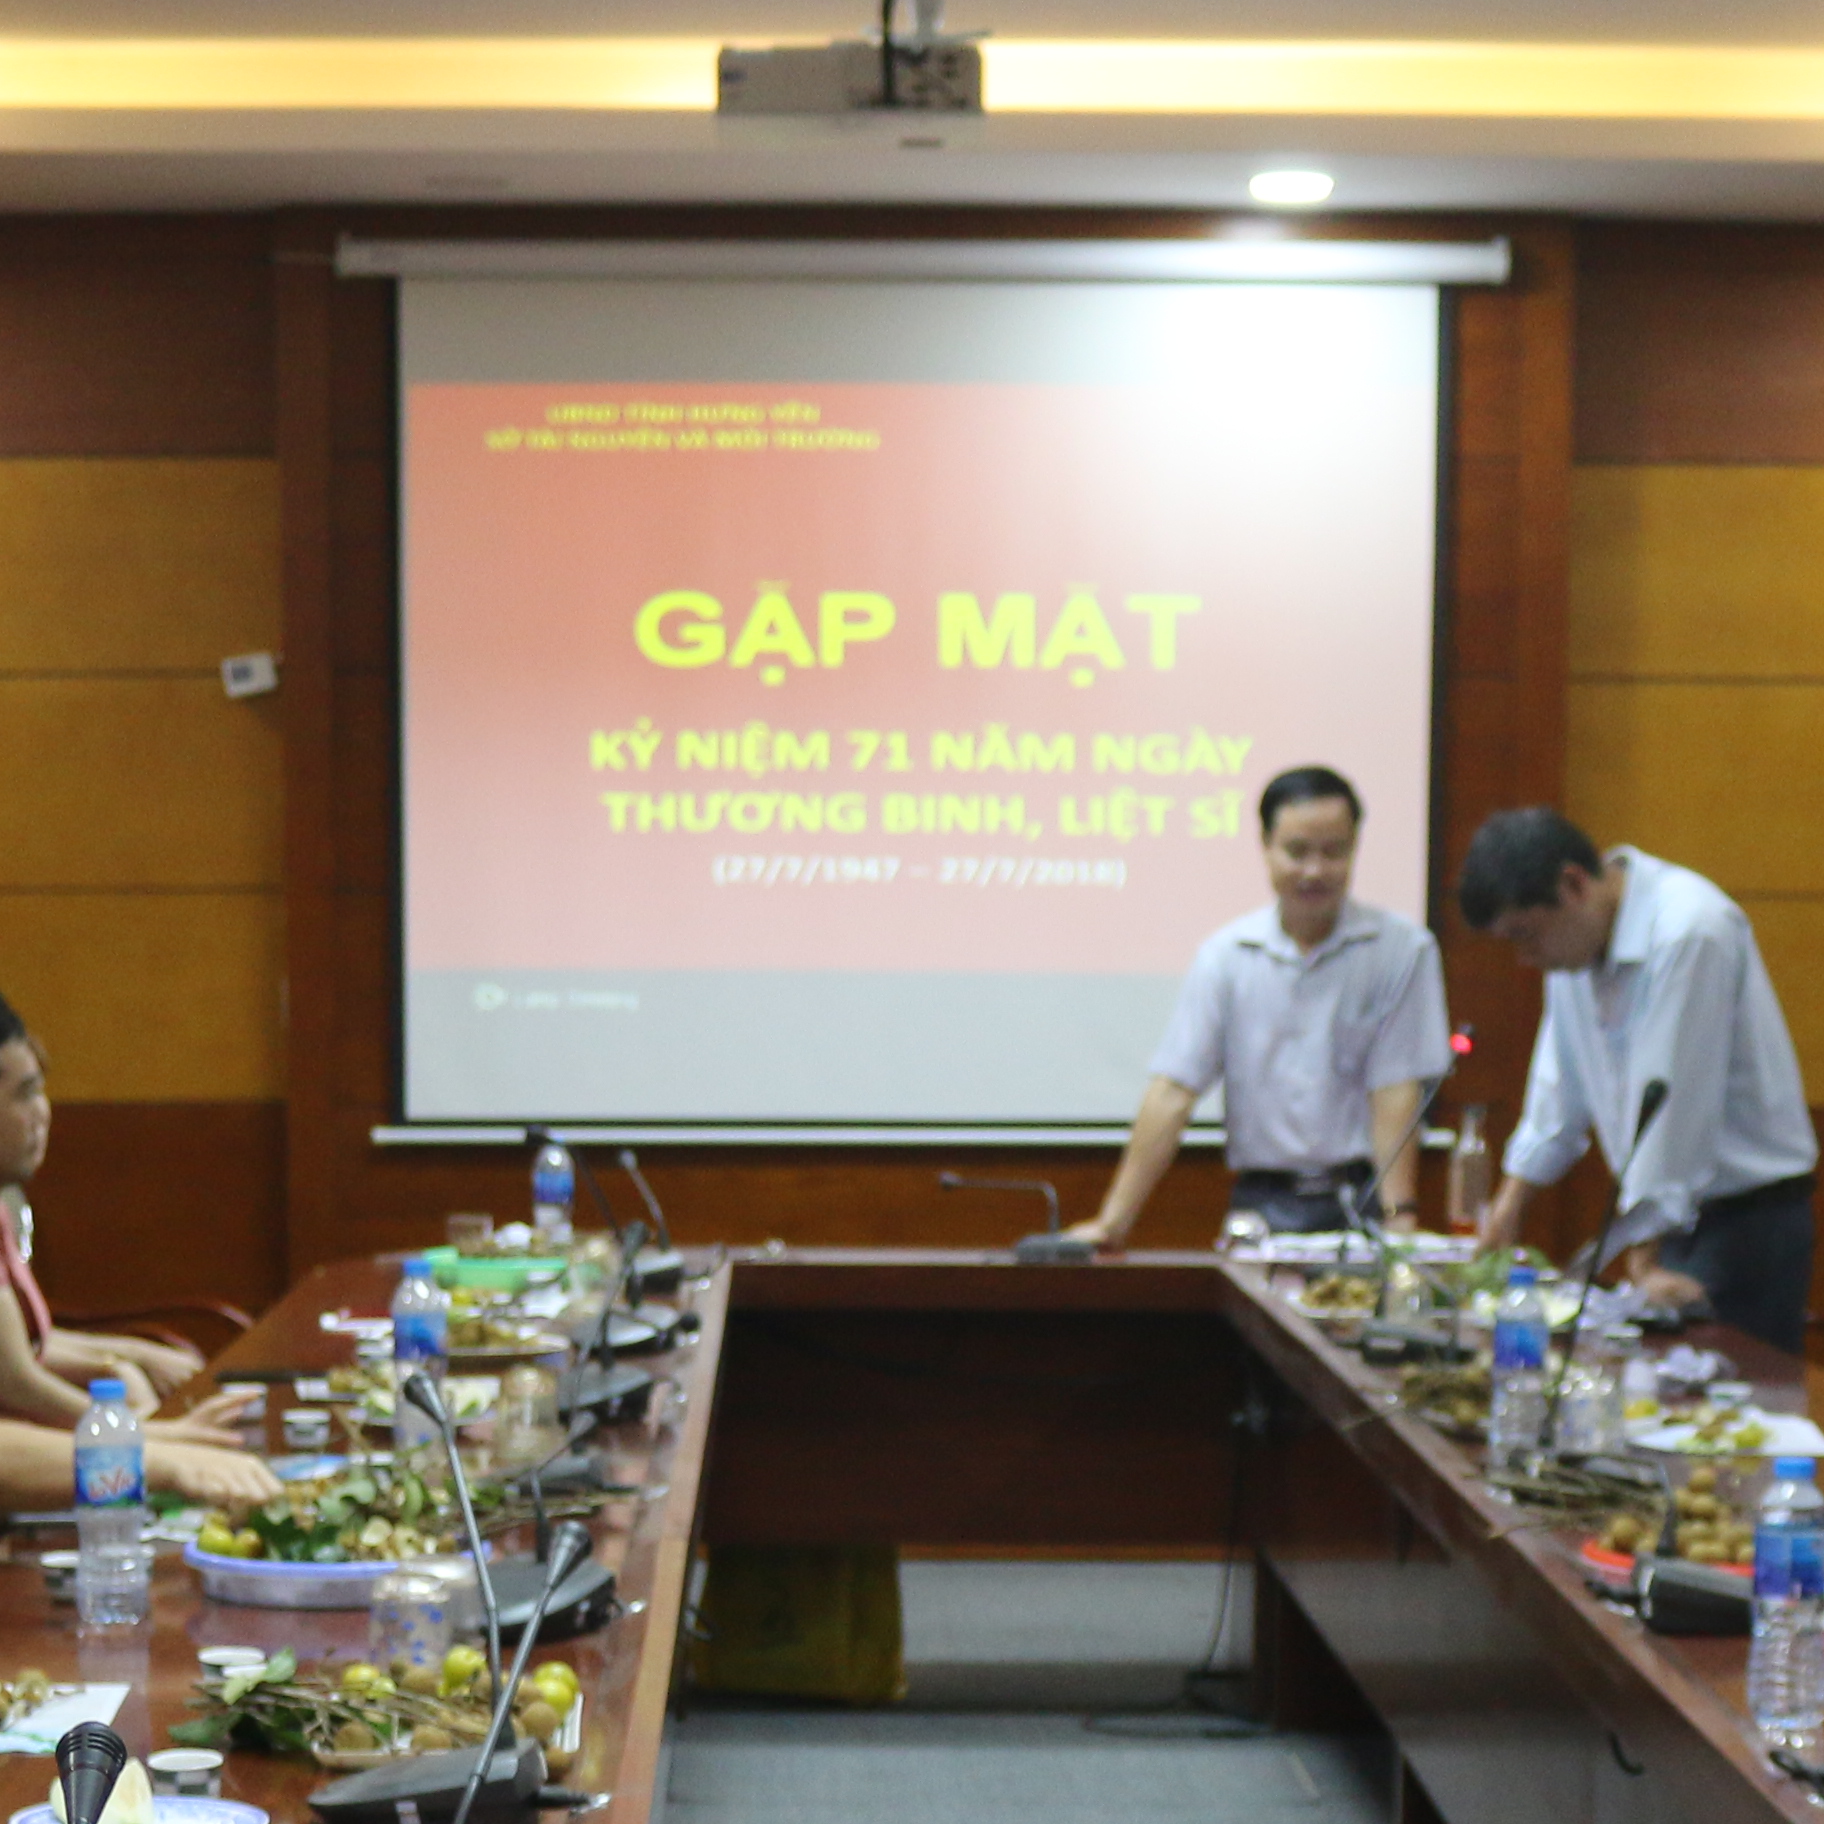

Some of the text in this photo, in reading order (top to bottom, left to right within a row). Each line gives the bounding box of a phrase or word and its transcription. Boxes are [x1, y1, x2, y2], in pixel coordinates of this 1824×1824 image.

[675, 718, 832, 779] NIỆM
[847, 730, 913, 773] 71
[929, 720, 1076, 773] NĂM
[1092, 722, 1254, 777] NGÀY
[599, 788, 868, 835] THƯƠNG
[881, 792, 1044, 842] BINH,
[1058, 785, 1176, 843] LIỆT
